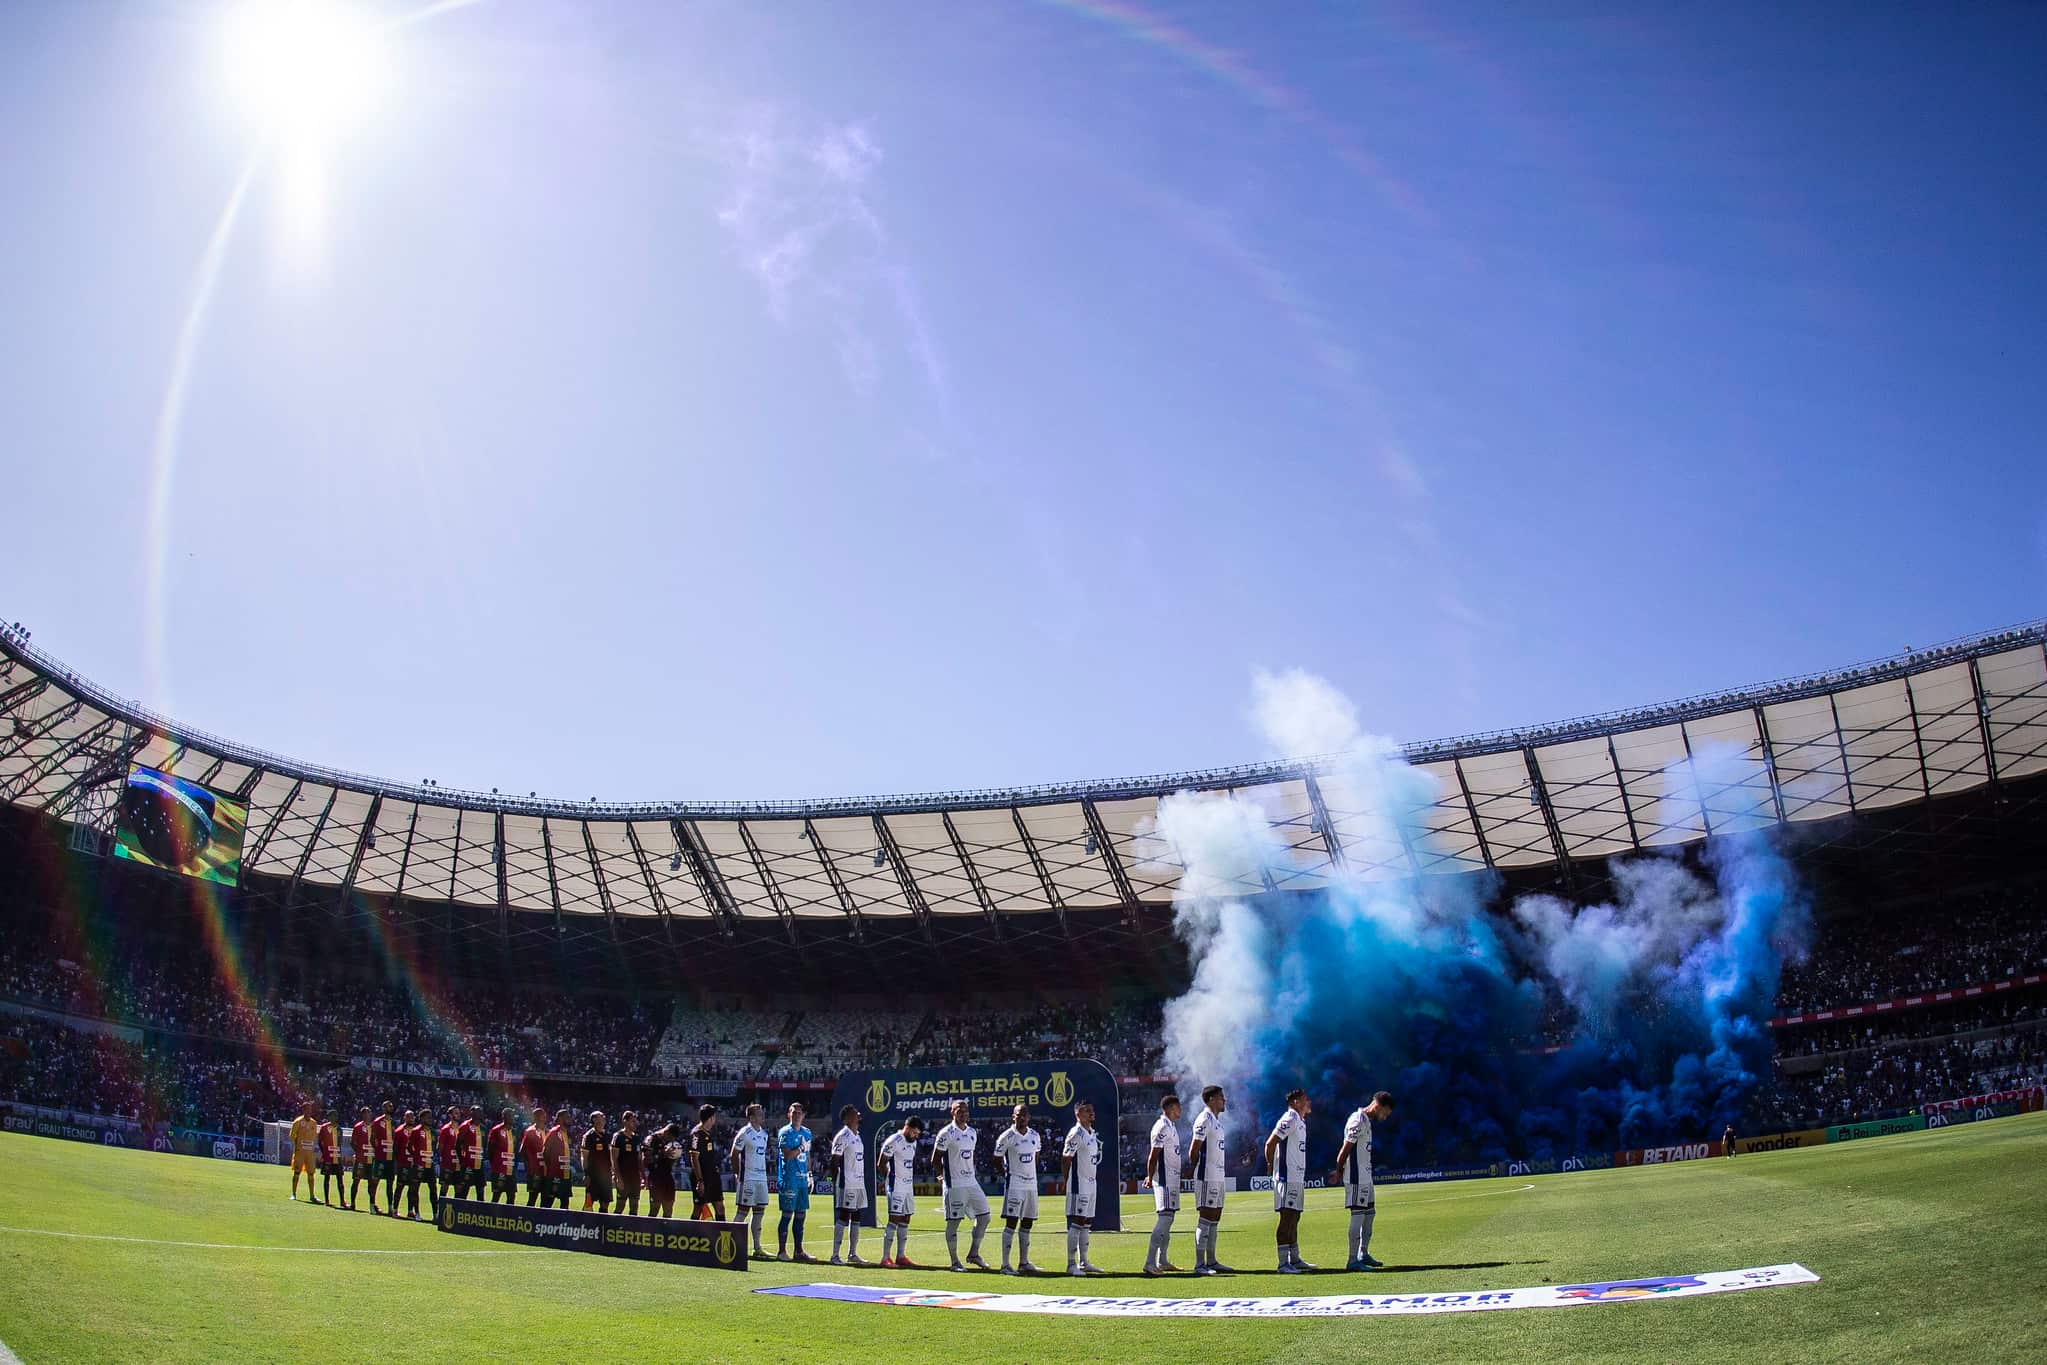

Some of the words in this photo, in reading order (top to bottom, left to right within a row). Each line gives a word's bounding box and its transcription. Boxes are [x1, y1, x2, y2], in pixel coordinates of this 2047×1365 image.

[895, 1073, 1039, 1096] BRASILEIRÃO
[978, 1092, 1025, 1108] SÉRIE
[1029, 1094, 1040, 1105] B
[38, 1122, 60, 1136] GRAU
[1746, 1133, 1801, 1152] vonder
[1643, 1143, 1709, 1164] BETANO
[457, 1212, 532, 1233] BRASILEIRÃO
[535, 1222, 599, 1241] sportingbet
[606, 1227, 651, 1245] SÉRIE
[654, 1234, 665, 1248] B
[667, 1235, 711, 1252] 2022
[1040, 1298, 1260, 1307] ADOTAR
[1338, 1292, 1514, 1306] AMOR
